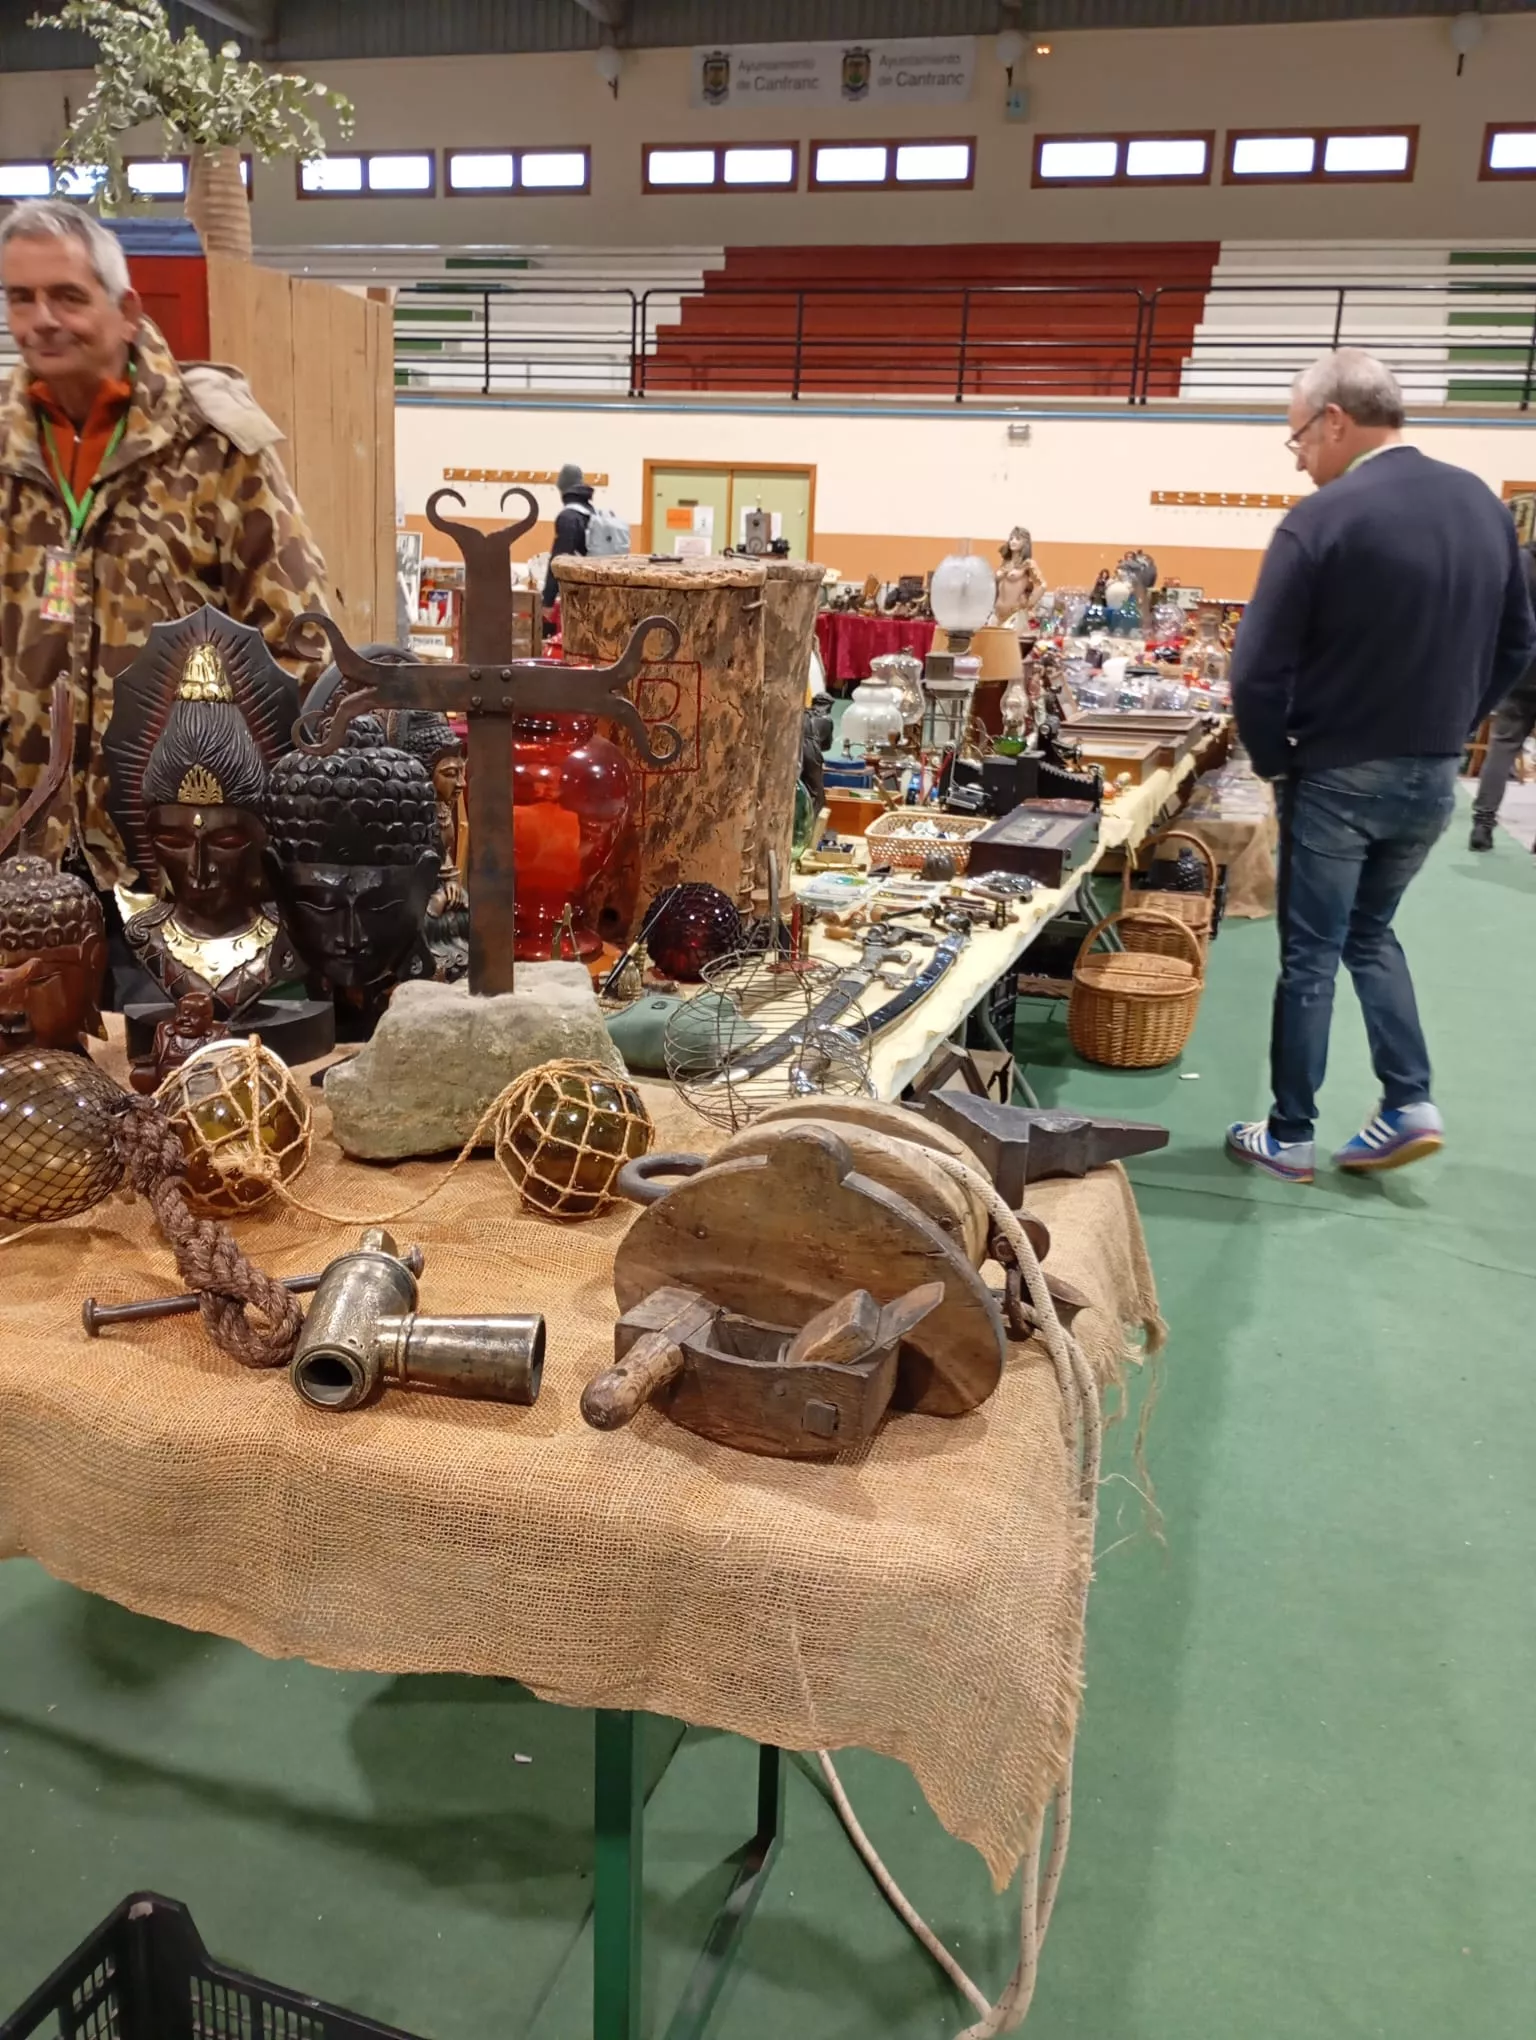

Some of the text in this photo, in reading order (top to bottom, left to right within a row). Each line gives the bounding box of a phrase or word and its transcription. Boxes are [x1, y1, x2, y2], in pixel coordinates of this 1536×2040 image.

[738, 58, 816, 74] Ayuntamiento
[879, 54, 961, 69] Ayuntamiento
[736, 74, 819, 92] de Canfranc
[877, 70, 965, 87] de Canfranc
